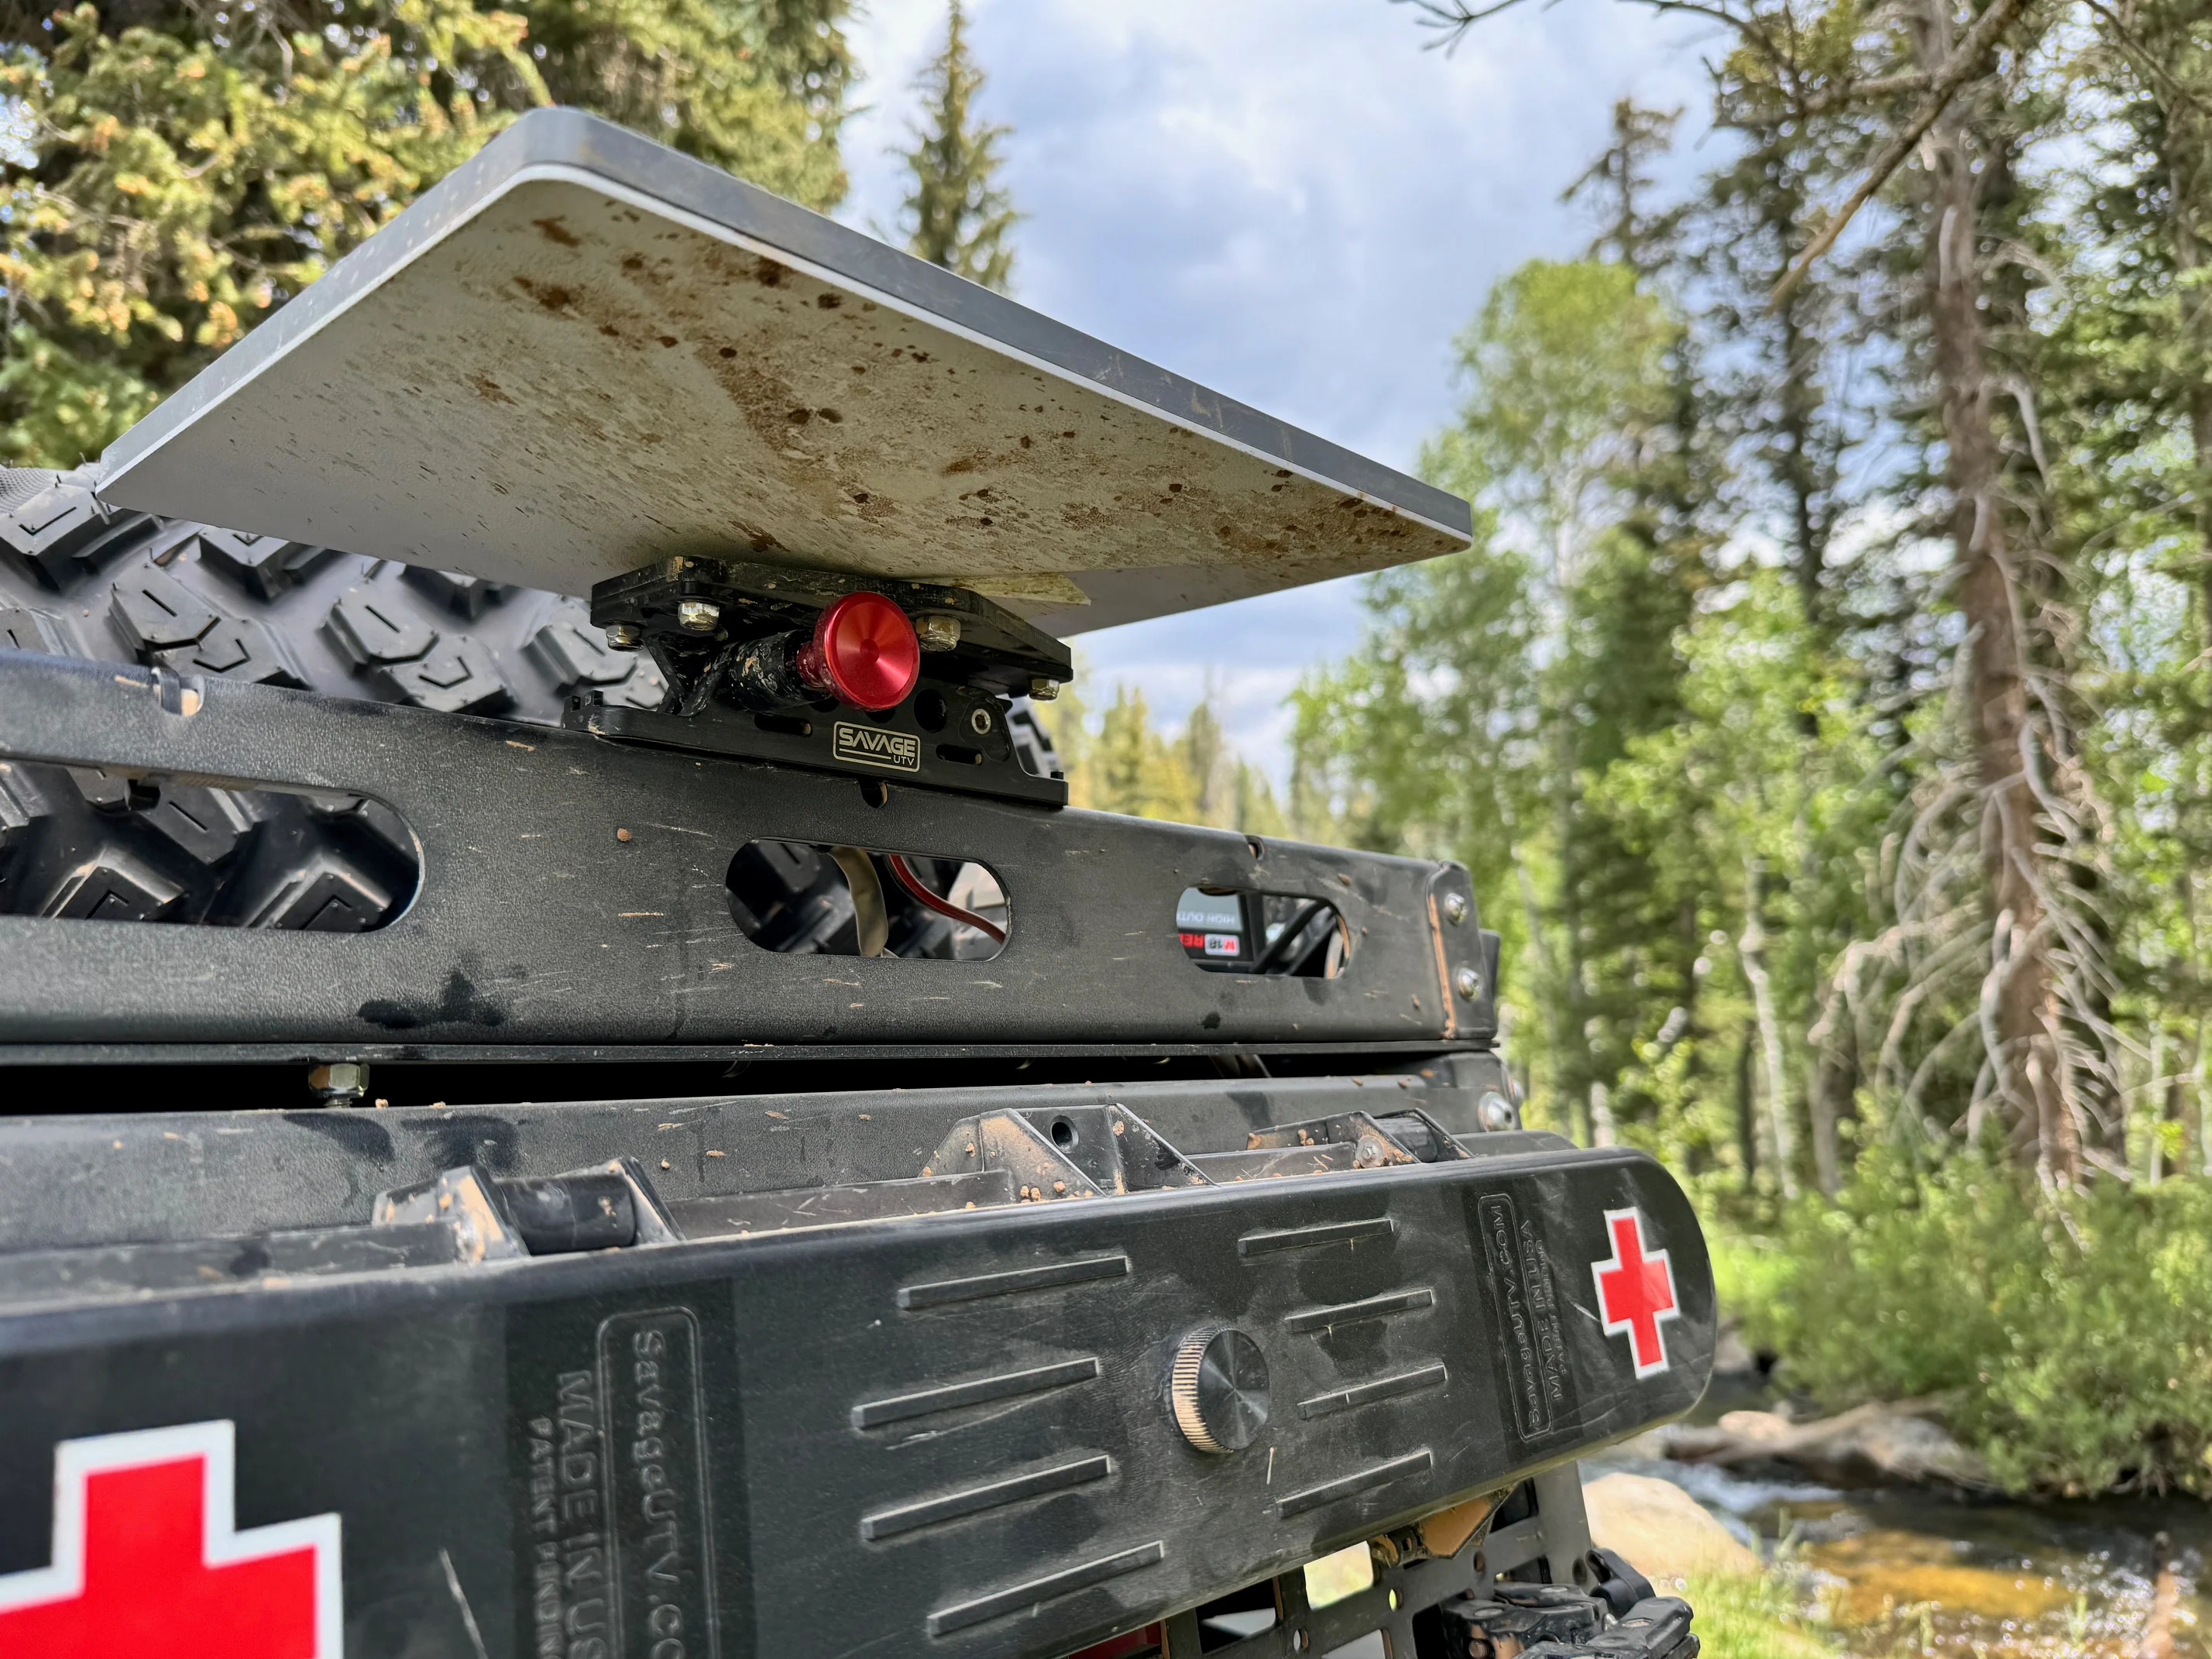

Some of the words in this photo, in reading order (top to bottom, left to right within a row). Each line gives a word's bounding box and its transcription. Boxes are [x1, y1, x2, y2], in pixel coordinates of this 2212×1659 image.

[839, 727, 915, 757] SAVAGE
[893, 754, 915, 766] UTV
[1520, 1220, 1539, 1275] USA
[1491, 1205, 1540, 1424] SavageUTV.COM
[1531, 1284, 1546, 1308] IN
[1537, 1318, 1562, 1400] MADE
[1550, 1314, 1567, 1374] PATENT
[528, 1414, 557, 1533] PATENT
[556, 1369, 598, 1521] MADE
[562, 1532, 603, 1587] IN
[534, 1540, 564, 1659] PENDIN
